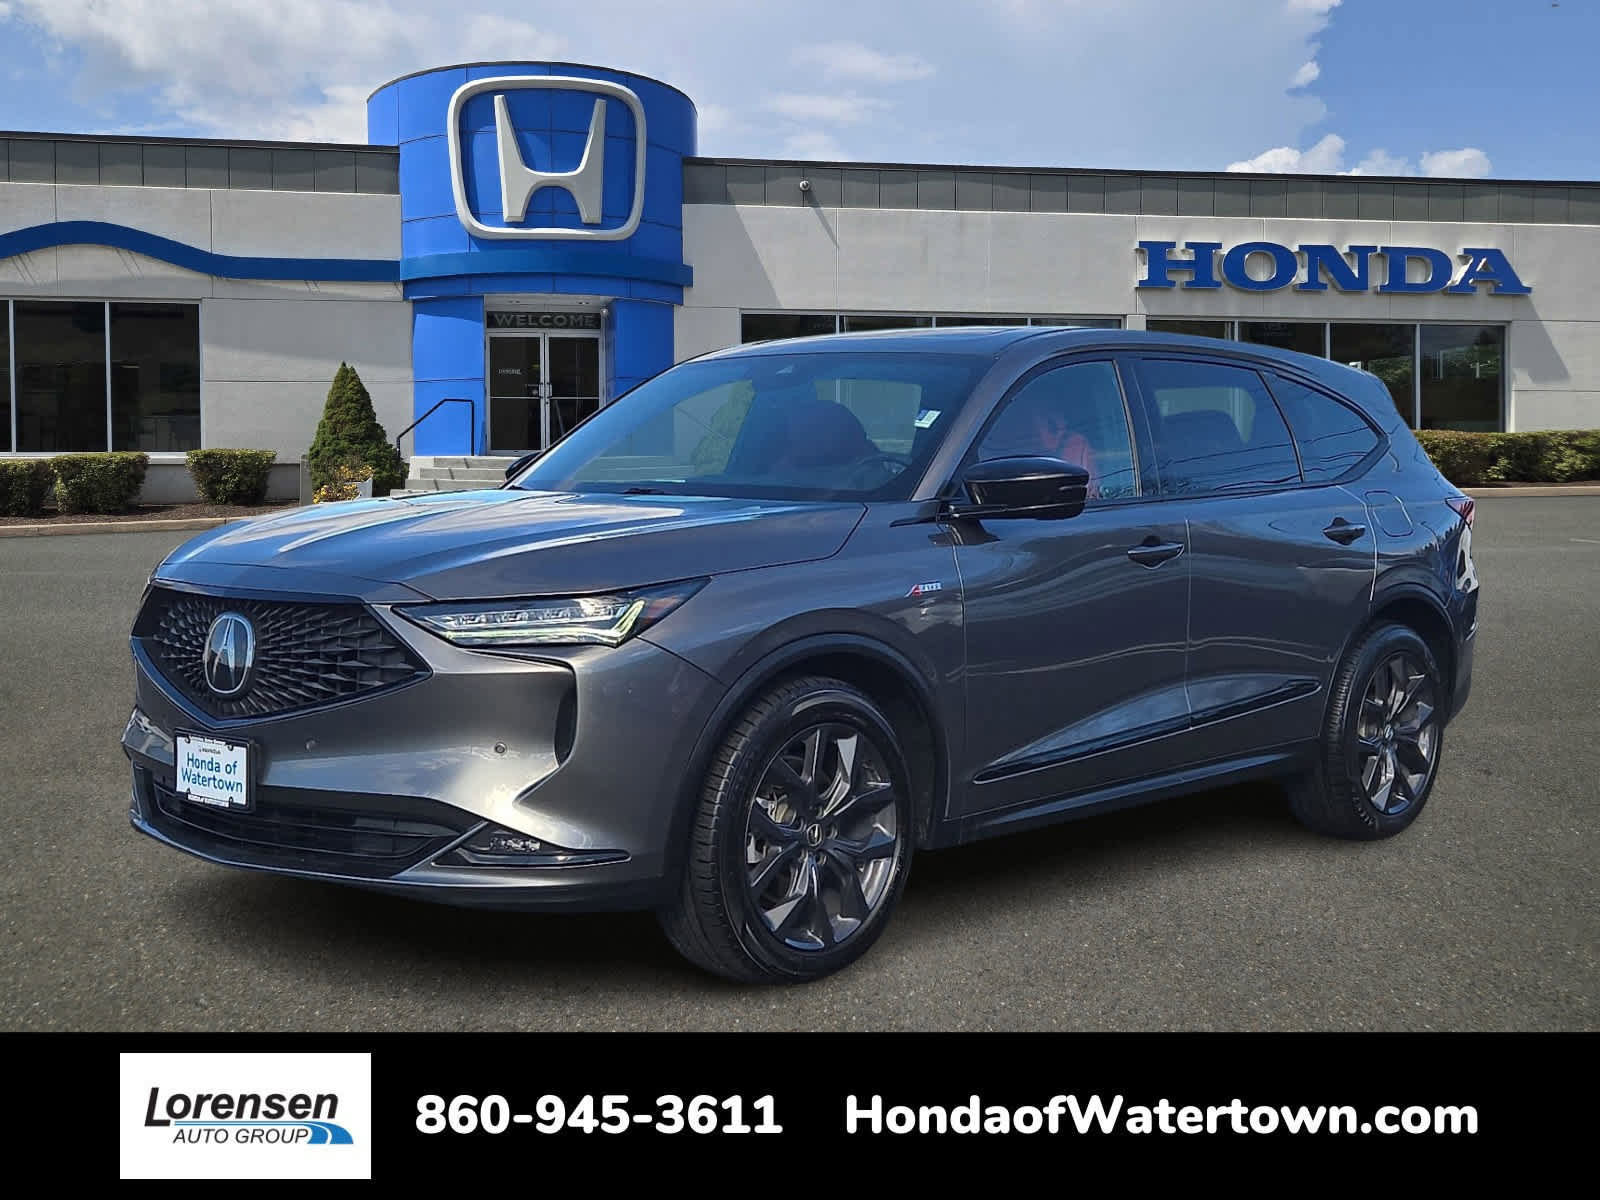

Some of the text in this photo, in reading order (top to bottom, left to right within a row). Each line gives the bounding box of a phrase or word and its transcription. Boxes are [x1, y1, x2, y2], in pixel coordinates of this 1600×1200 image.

[1136, 240, 1532, 296] HONDA
[494, 313, 596, 328] WELCOME
[187, 752, 237, 775] Honda of
[181, 767, 243, 793] Watertown
